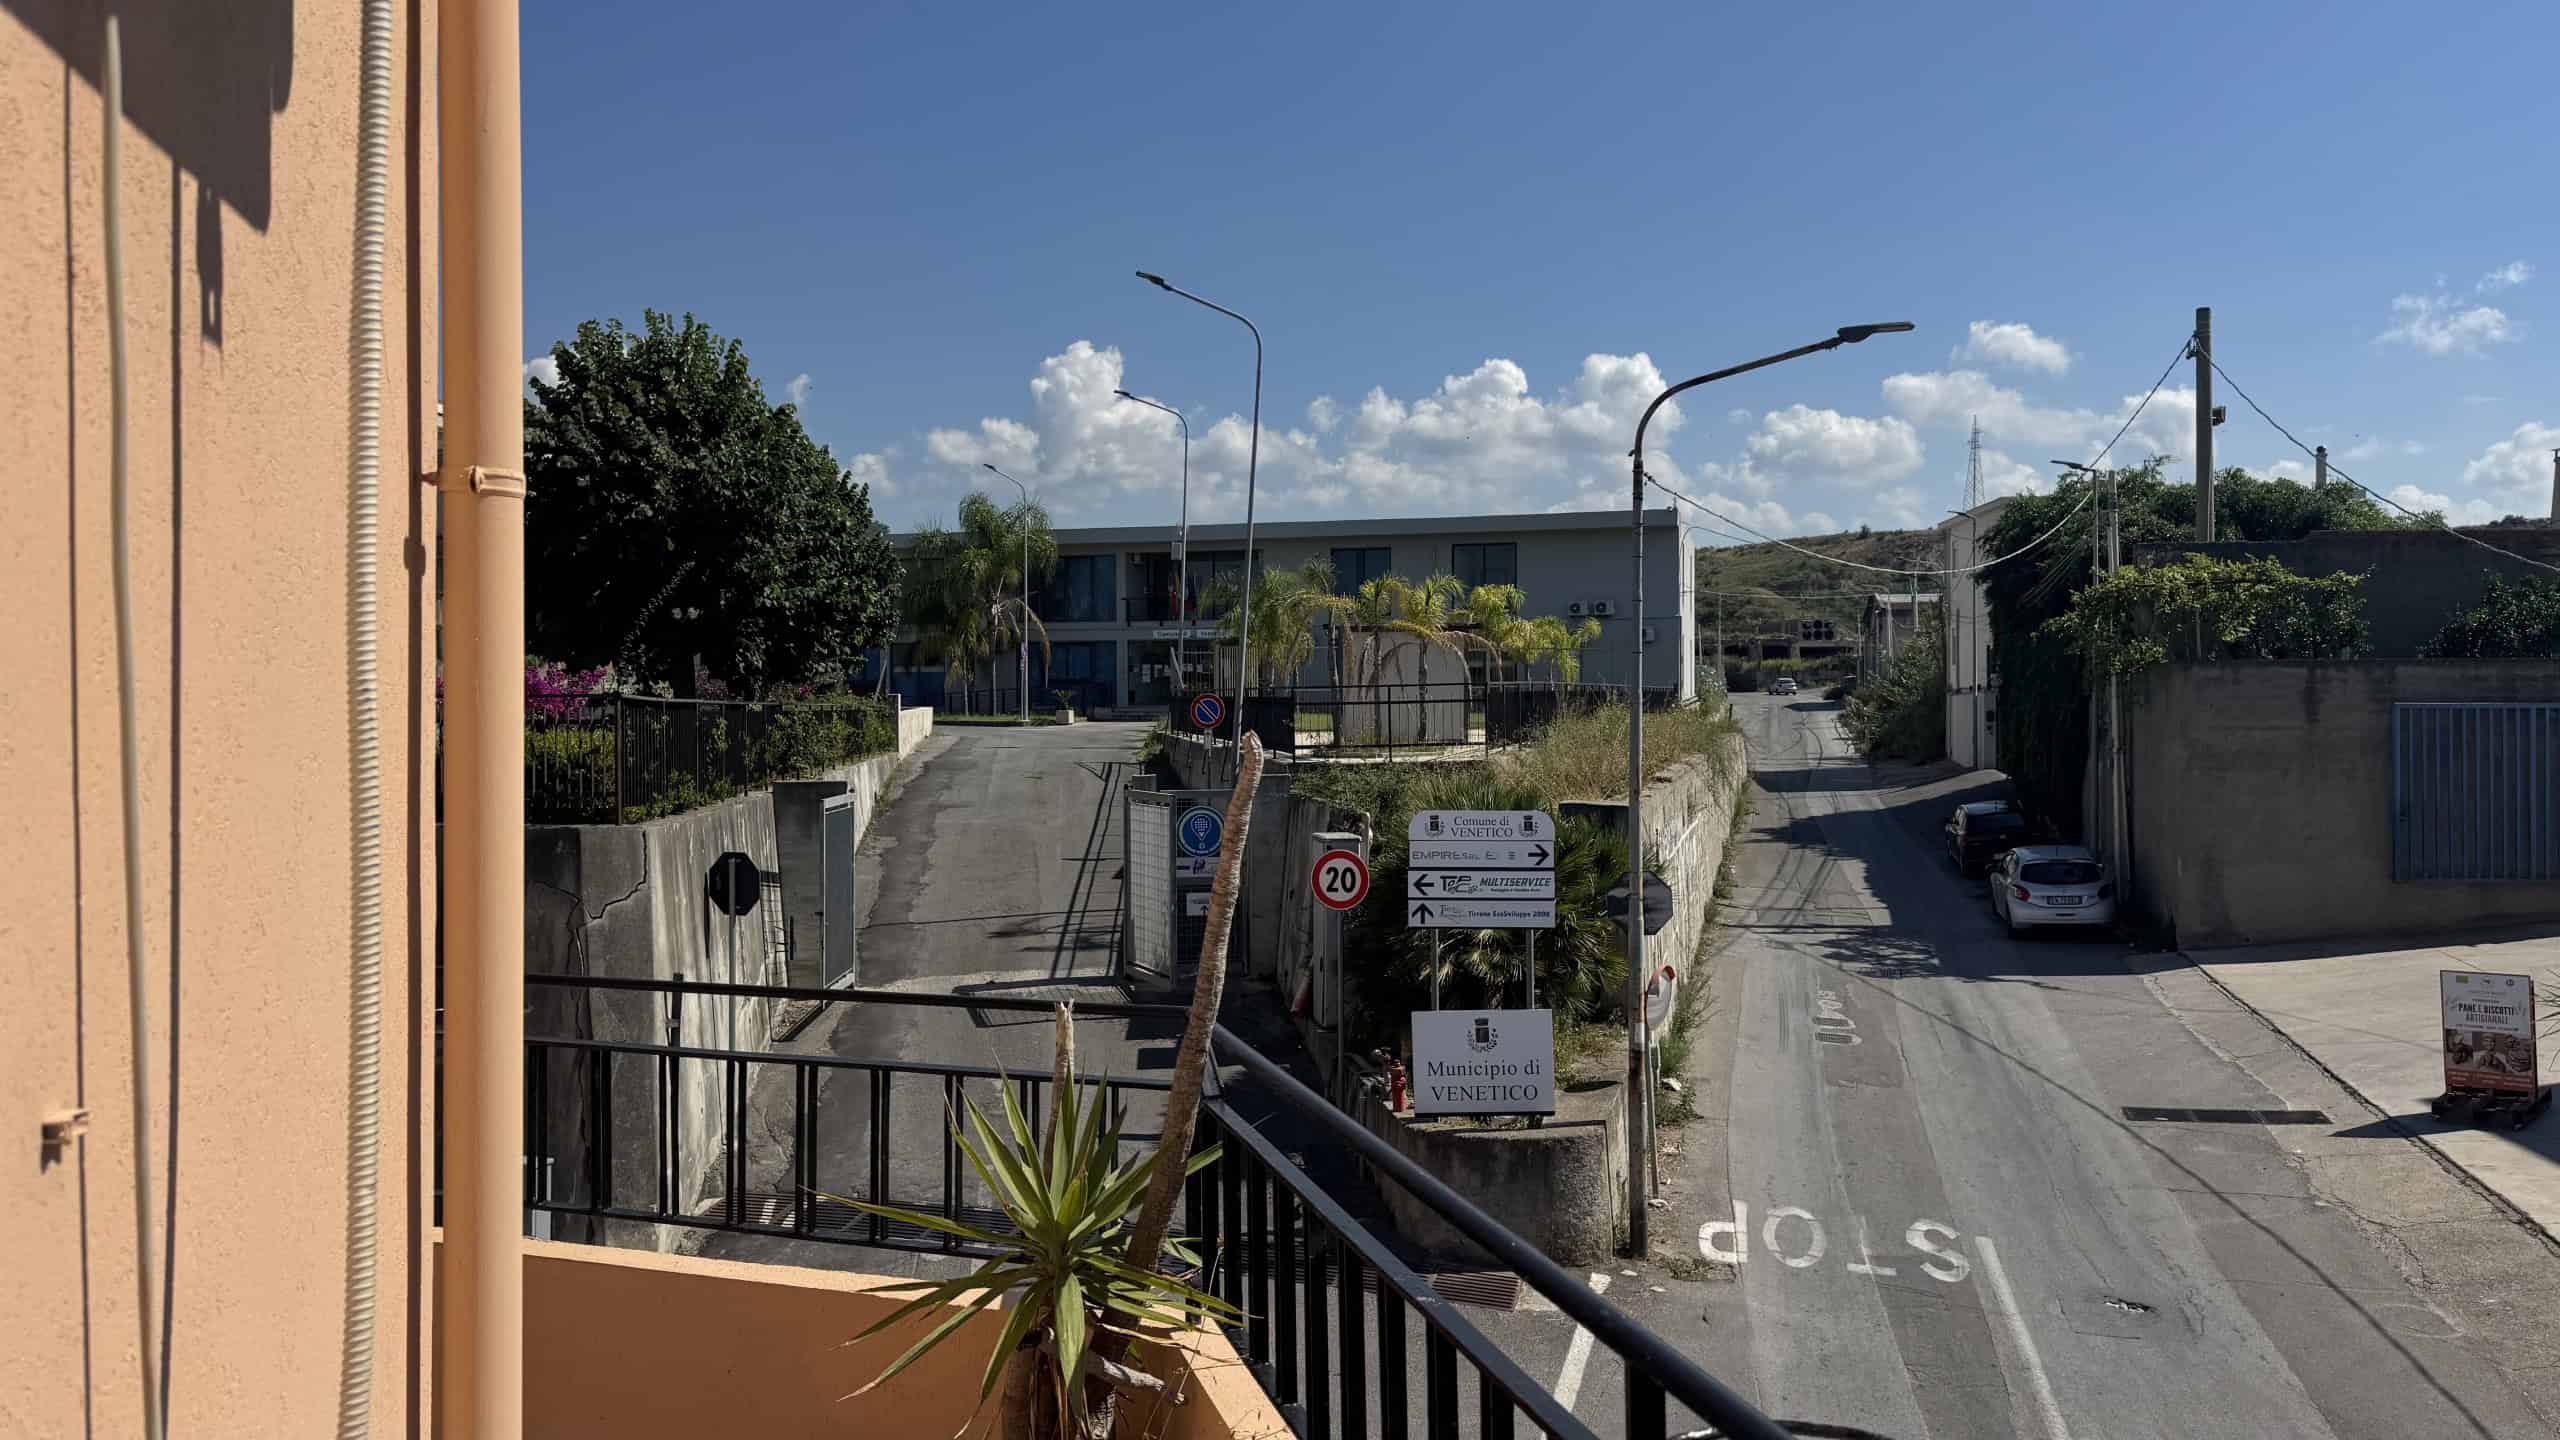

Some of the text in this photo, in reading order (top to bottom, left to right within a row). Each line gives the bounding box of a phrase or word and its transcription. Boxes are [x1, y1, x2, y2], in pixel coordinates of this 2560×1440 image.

[1454, 815, 1510, 826] Comune di
[1451, 827, 1513, 838] VENETICO
[1412, 850, 1461, 860] EMPIRE
[1325, 867, 1356, 893] 20
[1479, 877, 1552, 887] MULTISERVICE
[2458, 1002, 2476, 1013] PANE
[2484, 1005, 2514, 1016] BISCOTTI
[1427, 1060, 1541, 1080] Municipio di
[1431, 1085, 1538, 1101] VENETICO
[1698, 1200, 1971, 1283] STOP
